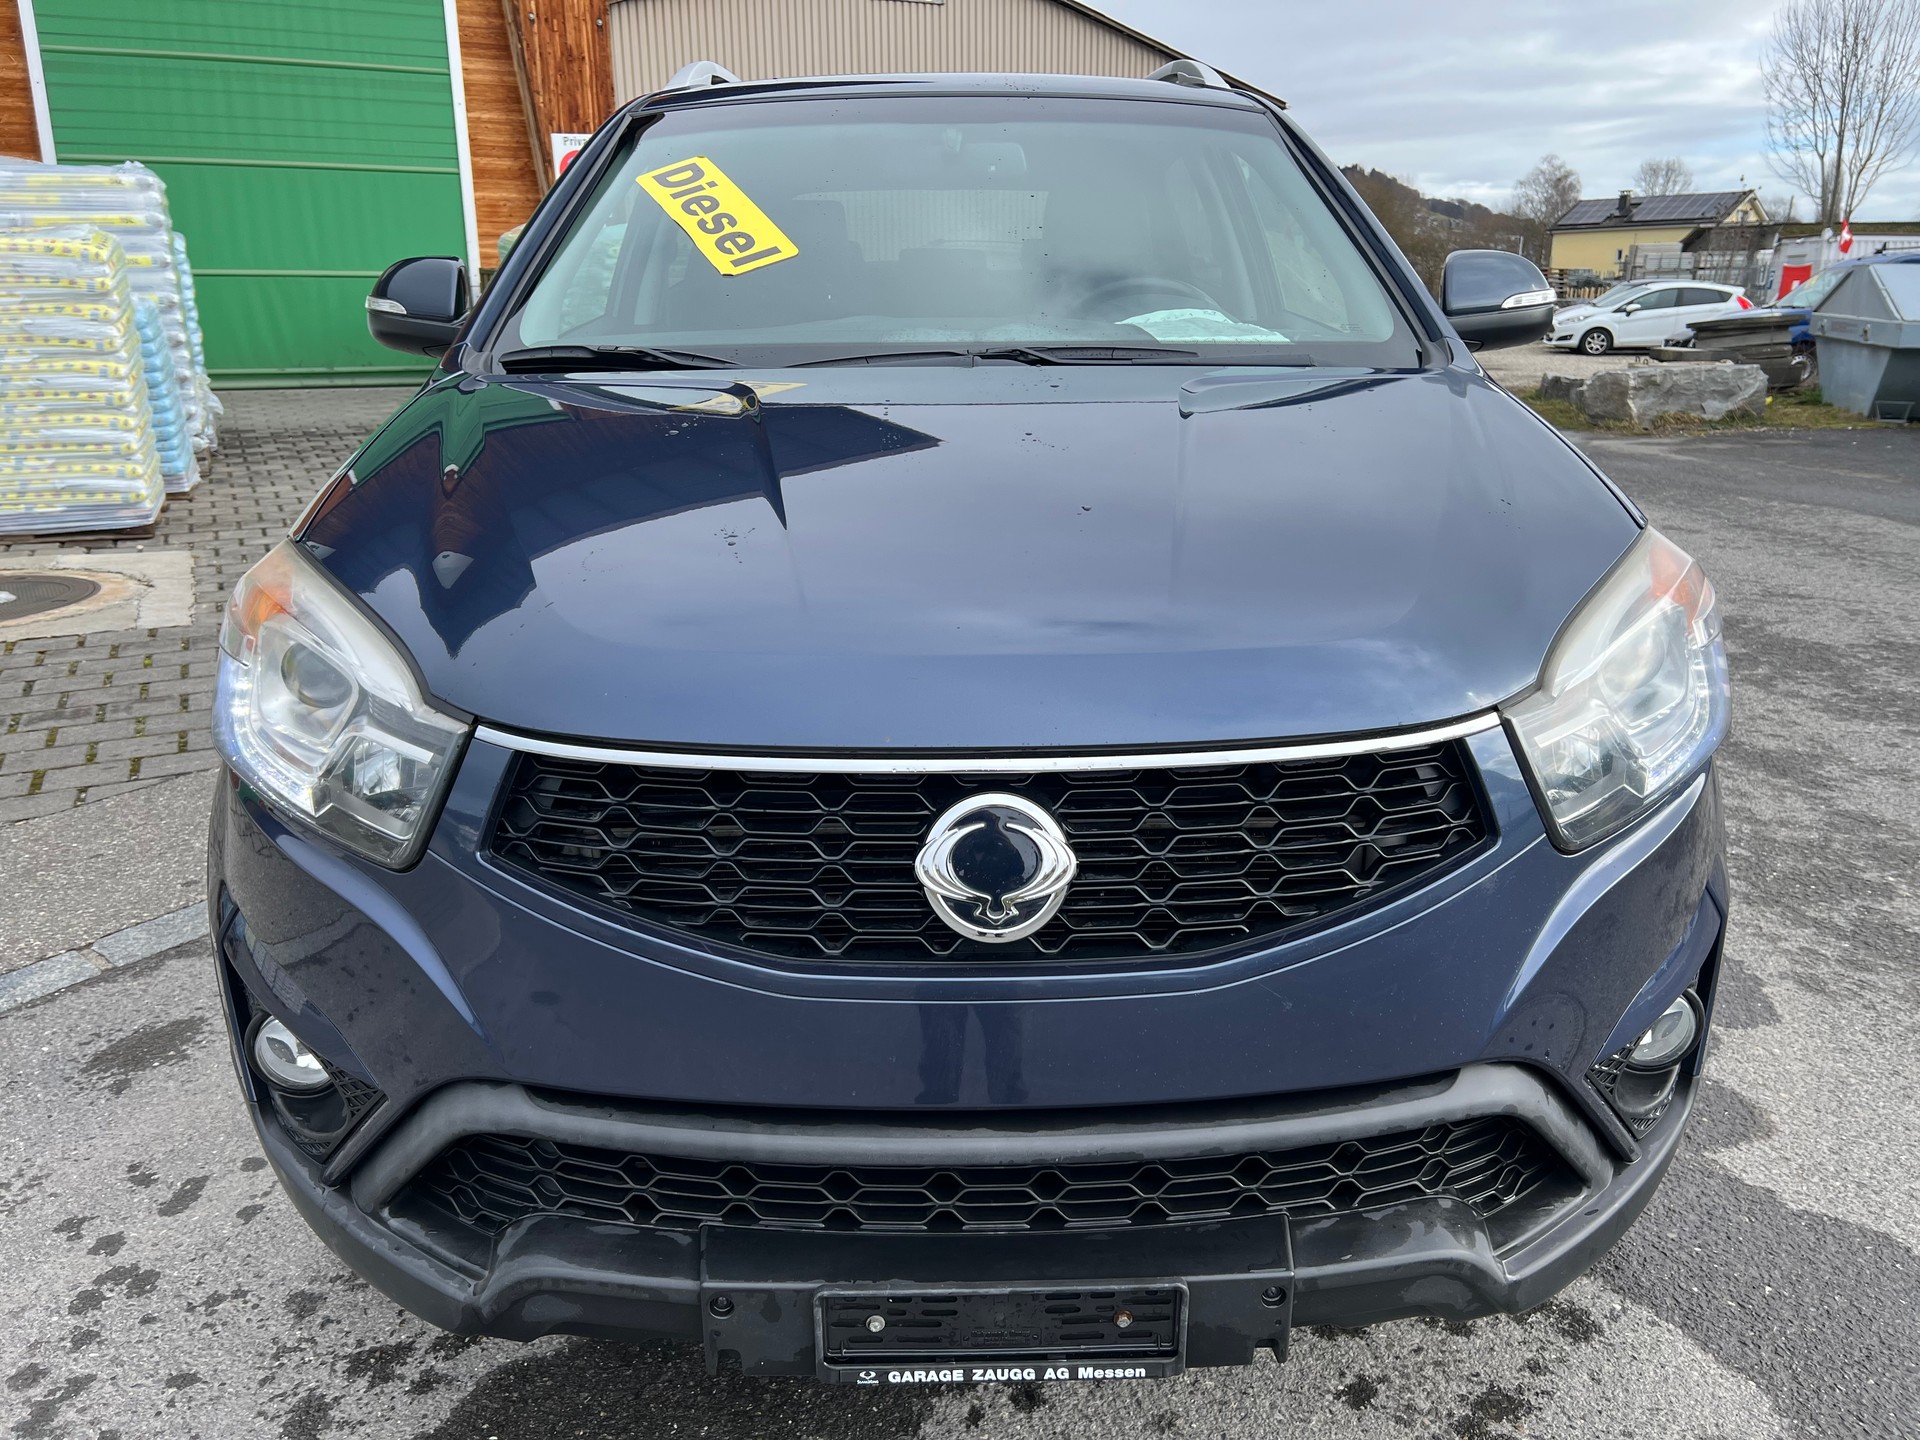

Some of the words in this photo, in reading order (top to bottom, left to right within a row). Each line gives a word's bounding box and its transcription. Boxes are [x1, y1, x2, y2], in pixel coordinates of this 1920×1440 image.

[651, 162, 782, 268] Diesel
[888, 1369, 964, 1383] GARAGE
[972, 1368, 1036, 1381] ZAUGG
[1043, 1367, 1070, 1380] AG
[1077, 1366, 1146, 1379] Messen
